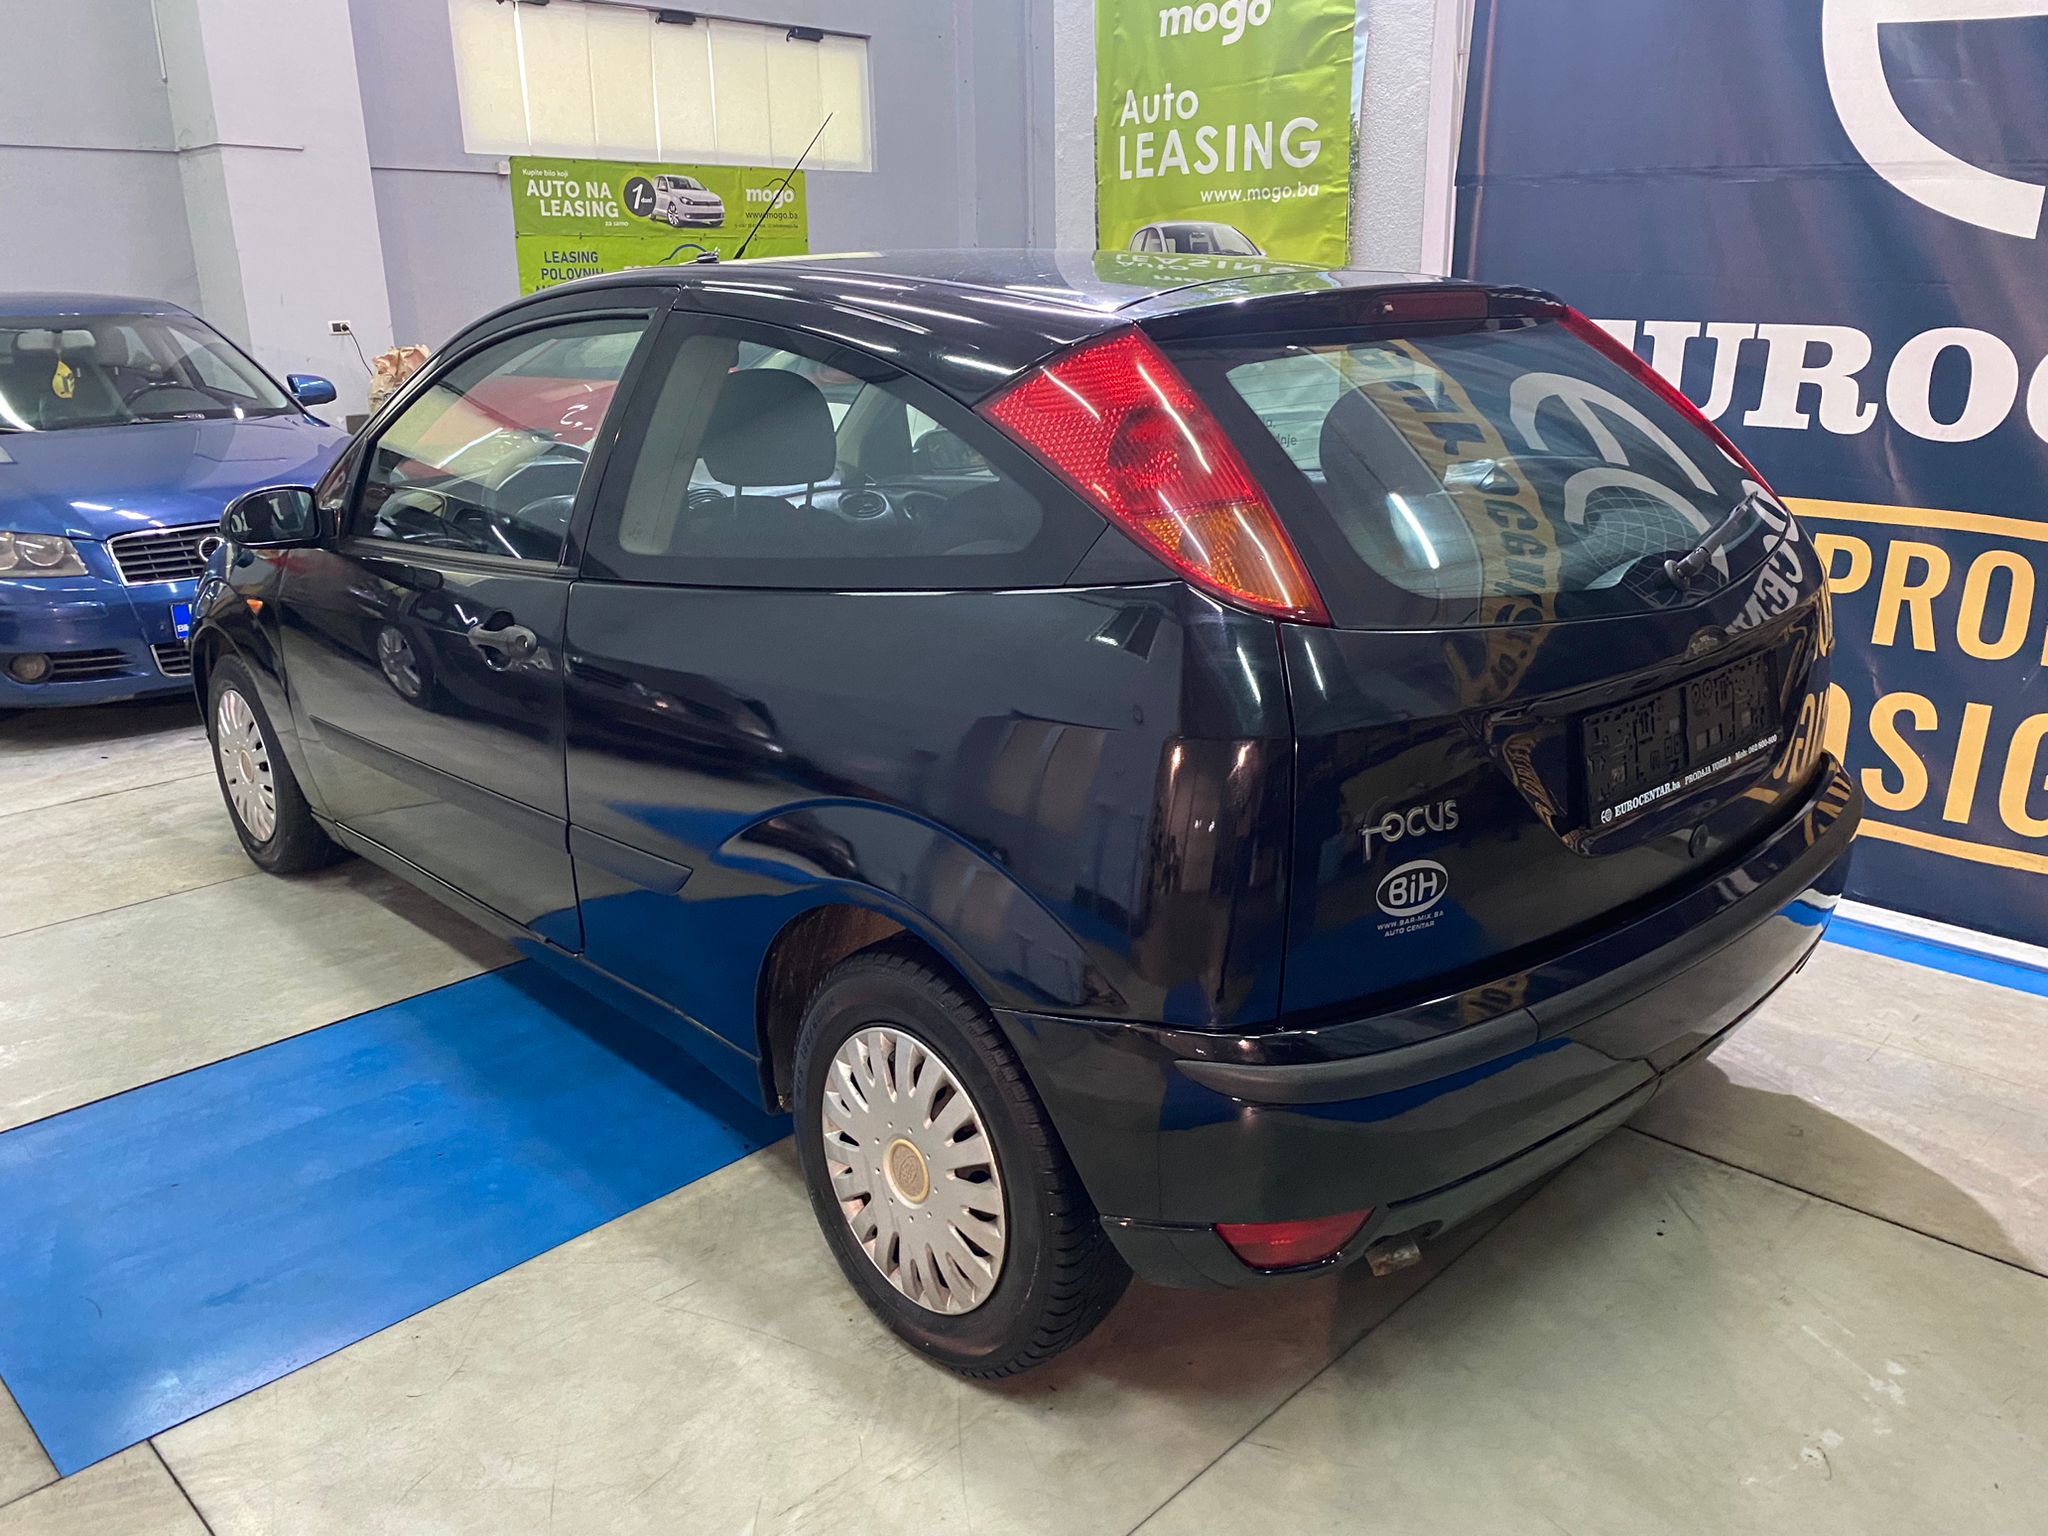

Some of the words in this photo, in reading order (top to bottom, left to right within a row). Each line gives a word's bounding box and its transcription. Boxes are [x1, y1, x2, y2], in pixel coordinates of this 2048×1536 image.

[1159, 0, 1272, 45] mogo
[1120, 83, 1199, 127] Auto
[1119, 117, 1321, 180] LEASING
[526, 179, 580, 198] AUTO
[586, 182, 612, 199] NA
[632, 183, 644, 210] 1
[745, 188, 795, 209] mogo
[1200, 181, 1320, 203] www.mogo.ba
[540, 199, 619, 218] LEASING
[544, 251, 598, 264] LEASING
[1588, 319, 2048, 443] URO
[1815, 533, 2048, 667] PRO
[1614, 780, 1681, 818] EUROCENTAR.ba
[1388, 872, 1438, 906] BiH
[1384, 926, 1405, 937] AUTO
[1406, 920, 1435, 933] CENTAR
